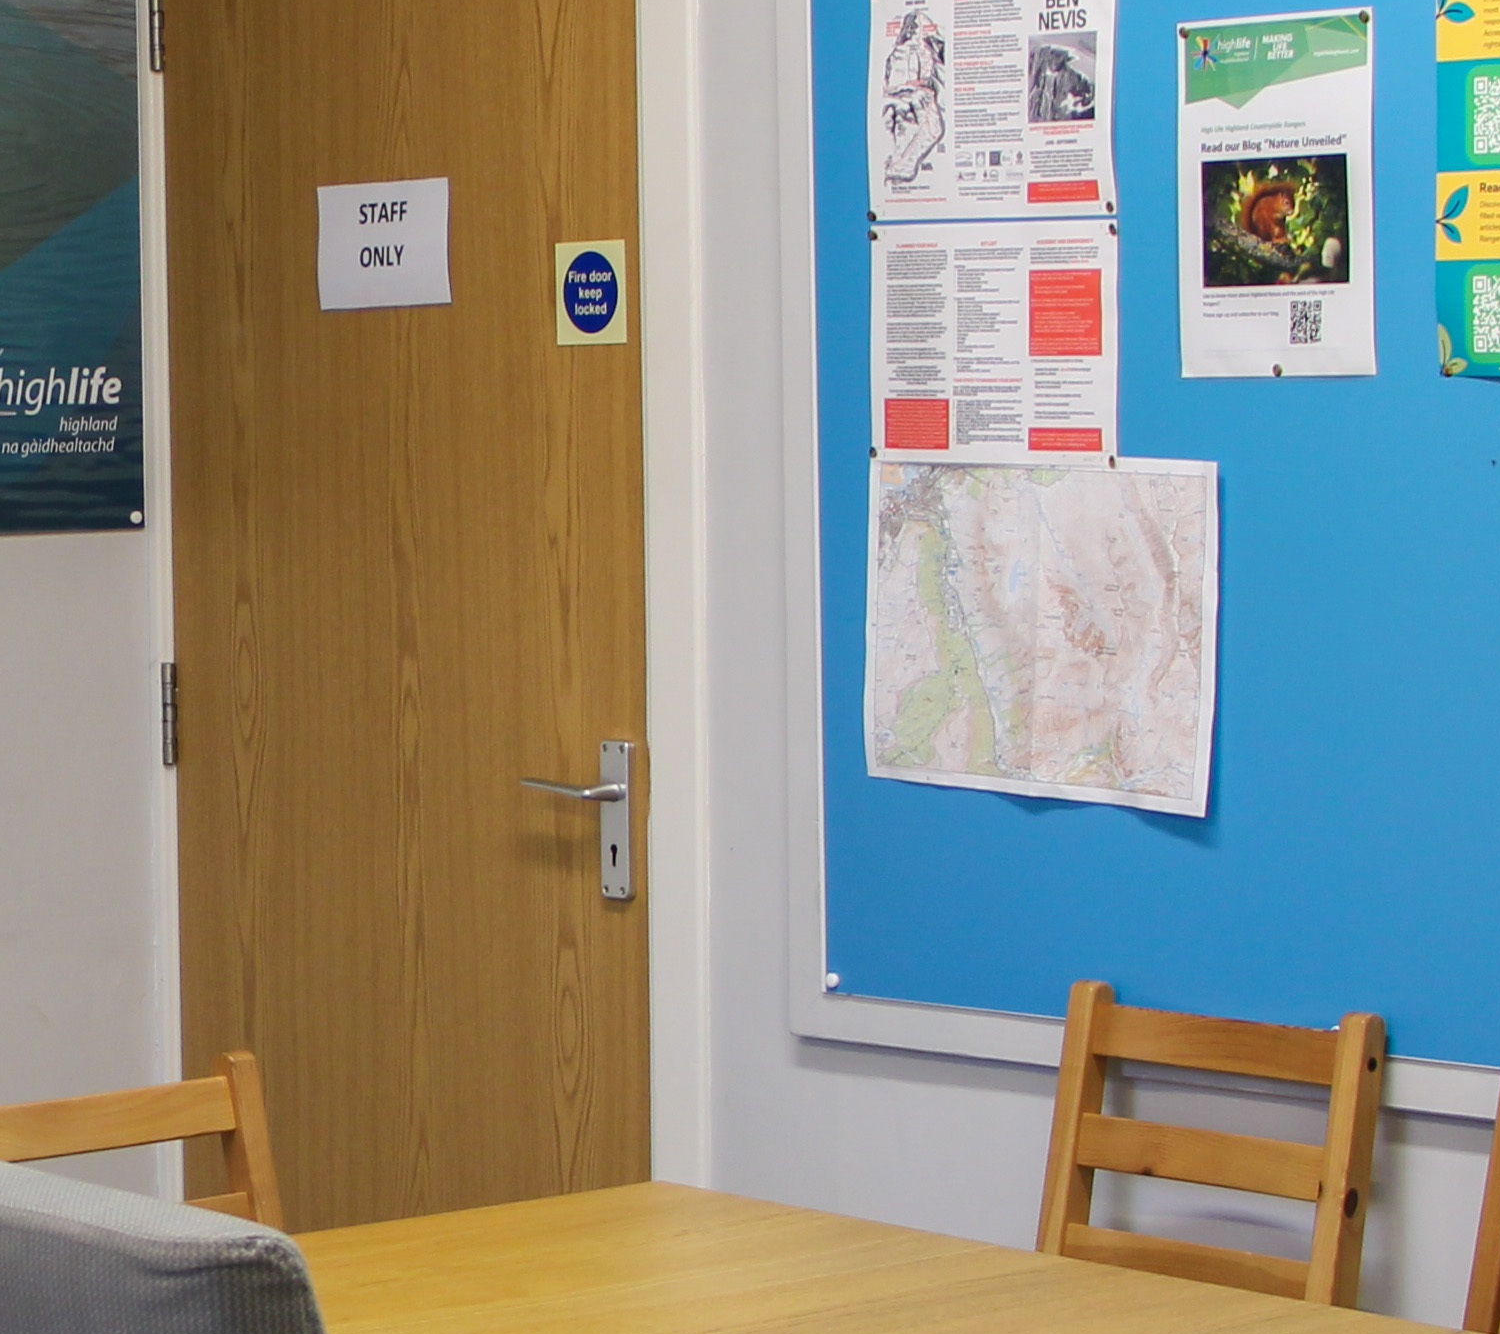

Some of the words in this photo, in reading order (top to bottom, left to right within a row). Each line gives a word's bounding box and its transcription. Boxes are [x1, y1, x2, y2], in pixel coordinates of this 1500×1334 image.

[1038, 9, 1086, 31] NEVIS
[1218, 39, 1251, 51] highlife
[1262, 33, 1292, 43] MAKING
[1268, 50, 1294, 59] BETTER
[1201, 142, 1222, 152] Read
[1242, 140, 1261, 150] Blog
[359, 201, 407, 224] STAFF
[360, 244, 404, 269] ONLY
[568, 270, 586, 282] Fire
[589, 270, 611, 282] door
[578, 286, 603, 301] keep
[574, 301, 607, 314] locked
[59, 415, 118, 435] highland
[1, 442, 18, 454] na
[21, 436, 115, 458] gàidhealtachd
